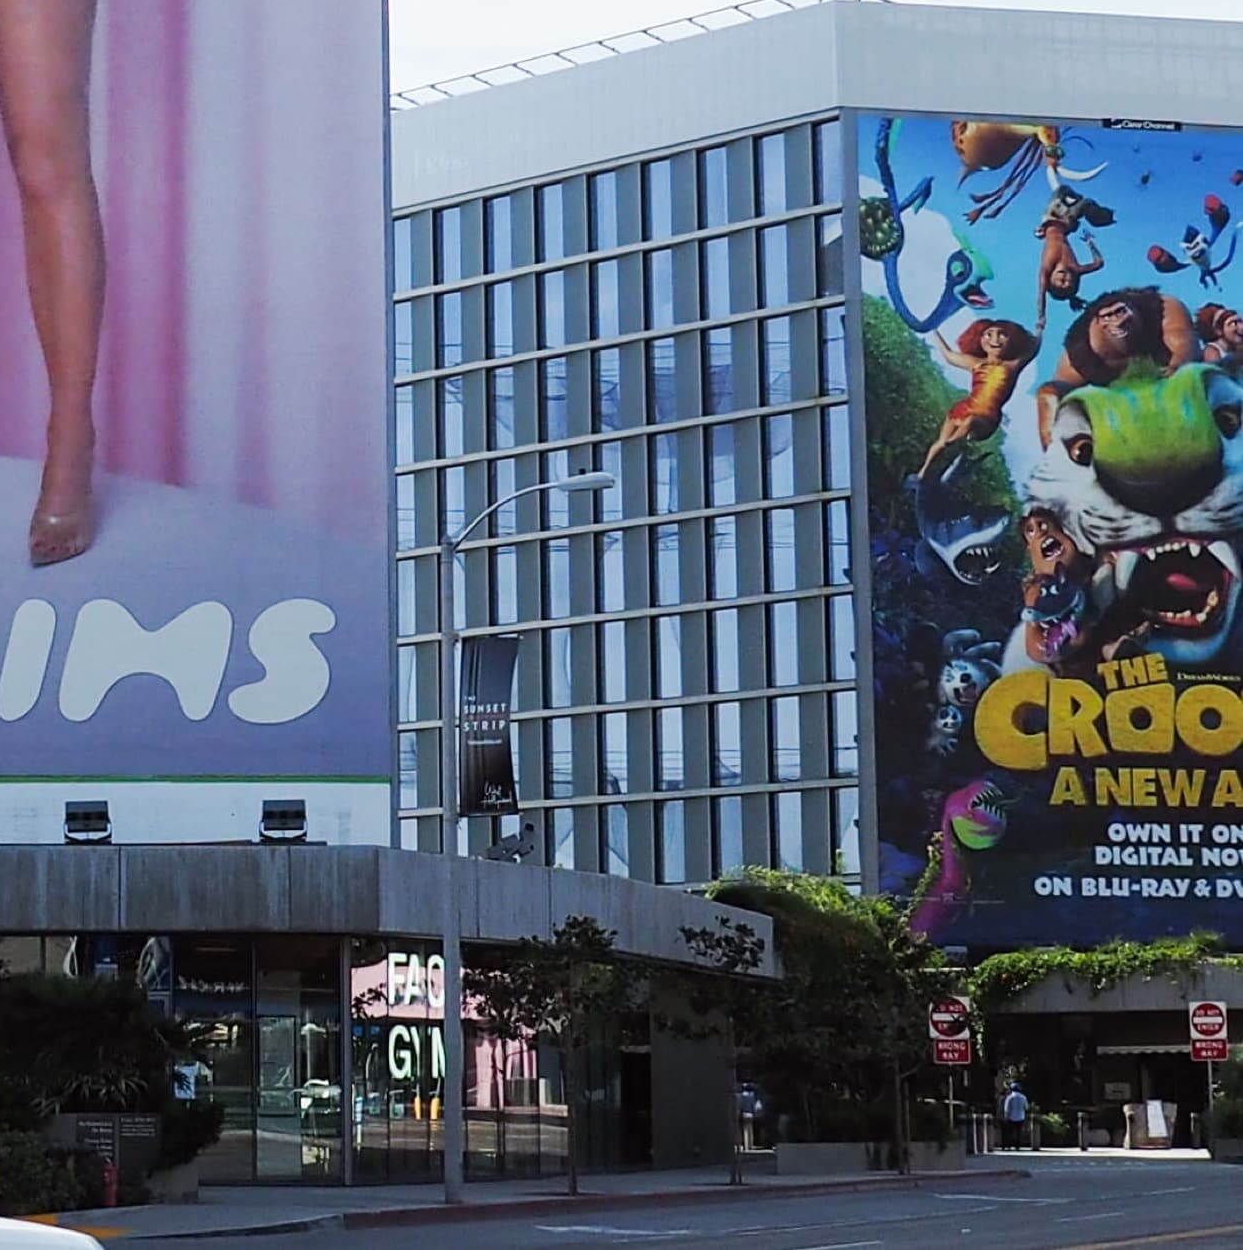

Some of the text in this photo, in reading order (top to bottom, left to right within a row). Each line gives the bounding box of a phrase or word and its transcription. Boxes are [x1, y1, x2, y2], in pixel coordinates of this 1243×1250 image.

[1097, 652, 1168, 689] THE
[463, 703, 507, 714] SUNSET
[974, 667, 1243, 771] CROO
[463, 720, 506, 731] STRIP
[1050, 767, 1087, 806] A
[1095, 767, 1206, 807] NEW
[1108, 823, 1243, 844] OWN IT ON
[1095, 845, 1193, 866] DIGITAL
[1034, 877, 1073, 896] ON
[1081, 877, 1191, 898] BLU-RAY
[1194, 878, 1211, 898] &
[388, 952, 446, 1008] FAC
